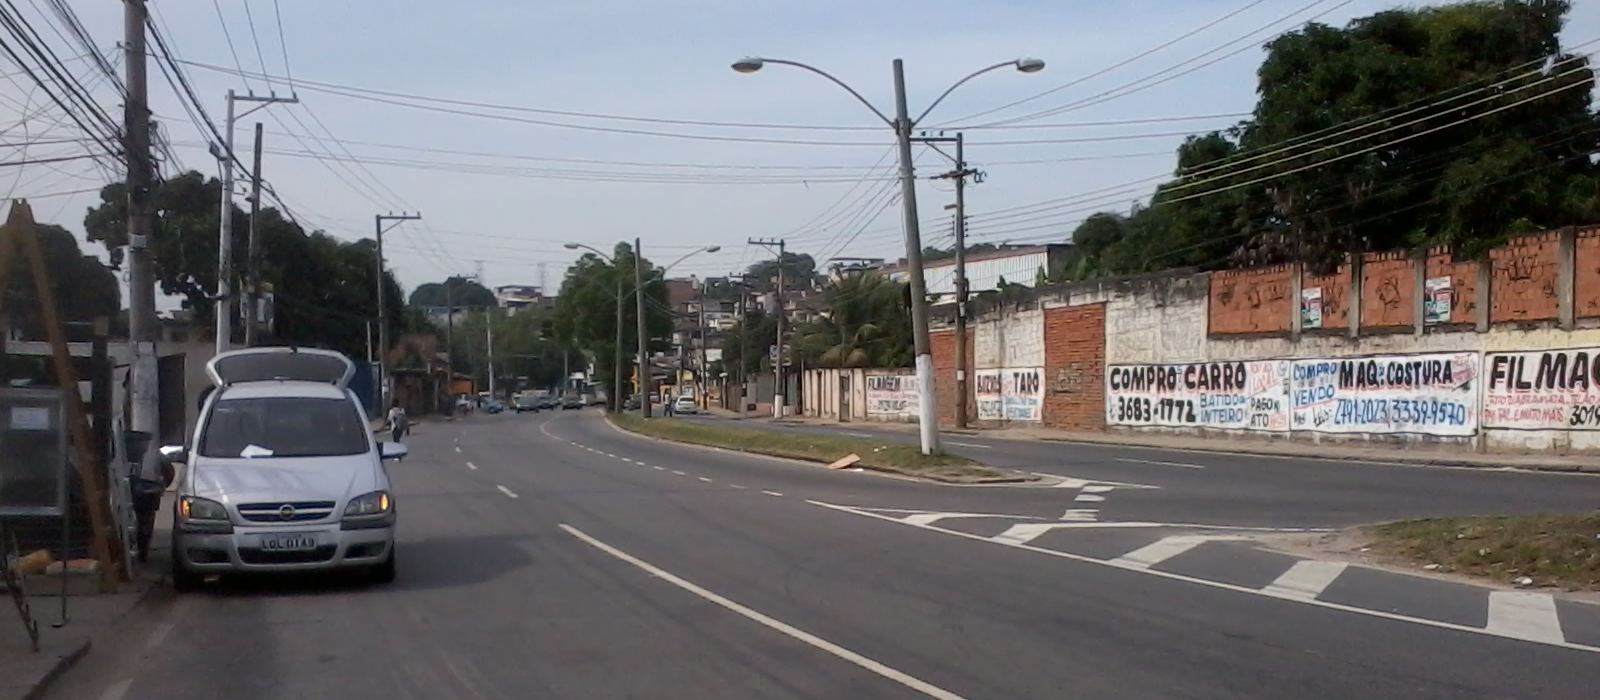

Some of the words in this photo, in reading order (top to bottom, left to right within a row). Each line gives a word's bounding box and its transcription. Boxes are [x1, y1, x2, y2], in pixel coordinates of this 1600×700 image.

[1110, 364, 1178, 393] COMPRO
[1184, 361, 1247, 391] CARRO
[1293, 362, 1337, 381] COMPRO
[1387, 359, 1453, 386] COSTURA
[1200, 393, 1238, 408] BATIDO
[1250, 397, 1273, 411] PAGO
[1294, 384, 1335, 407] VENDO
[1117, 396, 1196, 423] 3683-1772
[1200, 407, 1243, 423] INTEIRO
[1250, 413, 1270, 428] ATO
